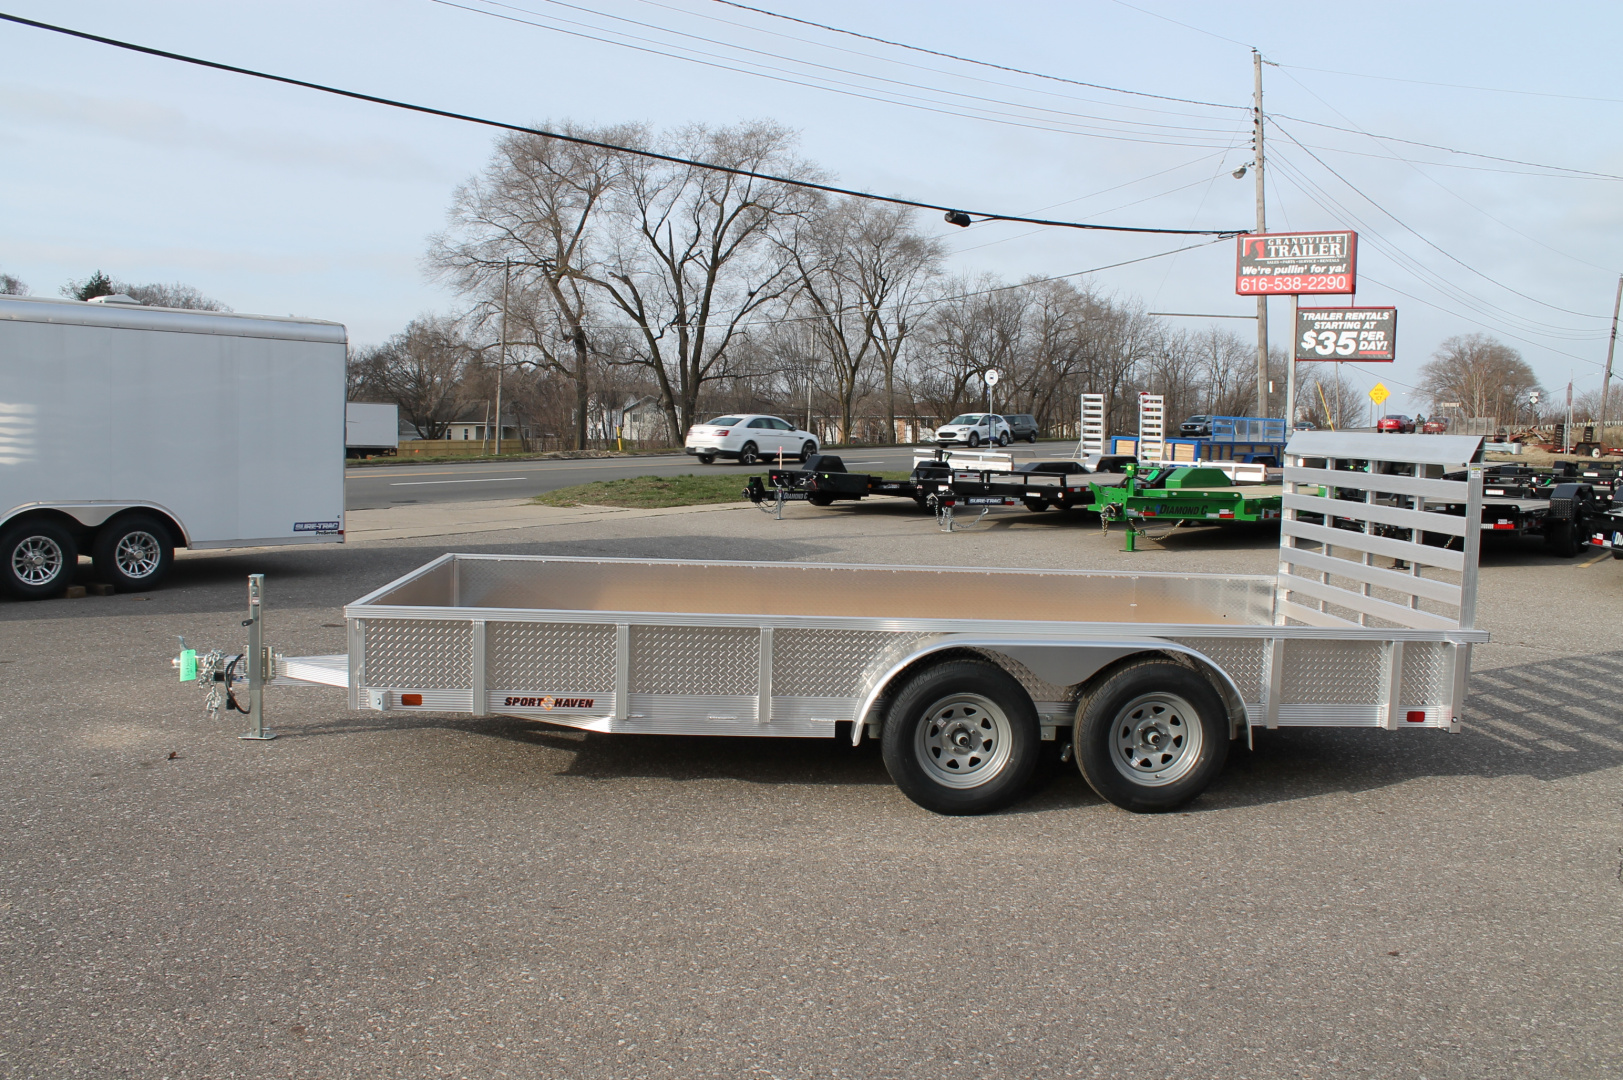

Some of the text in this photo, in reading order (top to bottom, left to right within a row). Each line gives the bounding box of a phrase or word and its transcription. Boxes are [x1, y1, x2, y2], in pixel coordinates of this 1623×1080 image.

[1268, 236, 1342, 245] GRANDVILLE
[1267, 243, 1341, 257] TRAILER
[1242, 263, 1347, 276] We're pullin' for ya!
[1240, 276, 1346, 291] 616-538-2290
[1303, 311, 1390, 321] TRAILER RENTALS
[1313, 321, 1377, 330] STARTING AT
[1301, 329, 1385, 355] $35 PER
[1358, 340, 1388, 350] DAY!
[1159, 504, 1199, 515] DIAMOND
[1200, 505, 1208, 515] C
[504, 697, 594, 708] SPORT HAVEN
